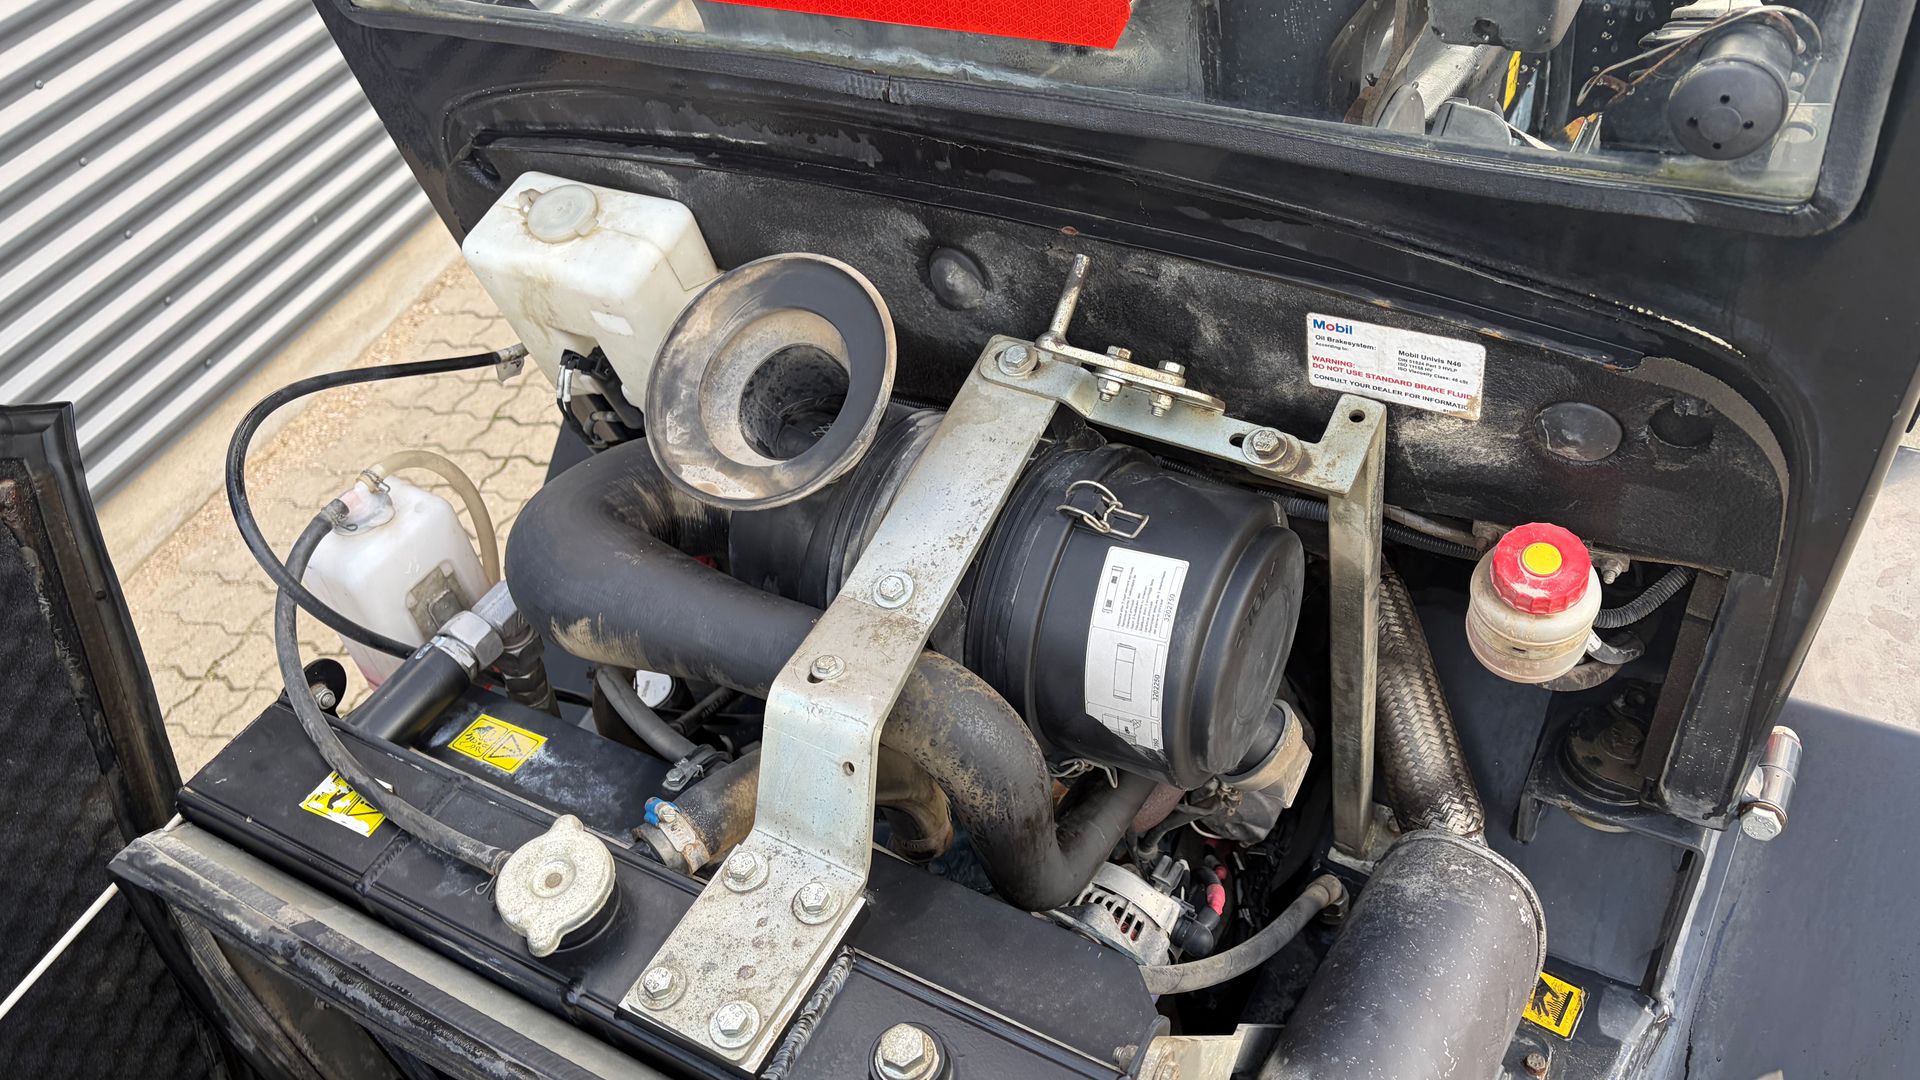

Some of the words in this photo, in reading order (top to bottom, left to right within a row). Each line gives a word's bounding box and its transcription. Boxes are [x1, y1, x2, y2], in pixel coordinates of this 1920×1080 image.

[1313, 319, 1352, 335] Mobil
[1315, 342, 1341, 350] According
[1327, 336, 1377, 351] Brakesystem:
[1312, 355, 1356, 368] WARNING:
[1398, 350, 1419, 359] Mobil
[1420, 354, 1445, 364] Univis
[1447, 360, 1462, 368] N46
[1409, 368, 1433, 378] Viscosity
[1327, 365, 1345, 373] NOT
[1346, 369, 1364, 377] USE
[1365, 372, 1413, 387] STANDARD
[1414, 383, 1446, 394] BRAKE
[1447, 390, 1473, 400] FLUID
[1314, 374, 1348, 384] CONSULT
[1349, 380, 1371, 389] YOUR
[1372, 385, 1403, 396] DEALER
[1404, 392, 1421, 400] FOR
[1422, 396, 1471, 411] INFORMATIO
[1163, 593, 1176, 623] 3202750
